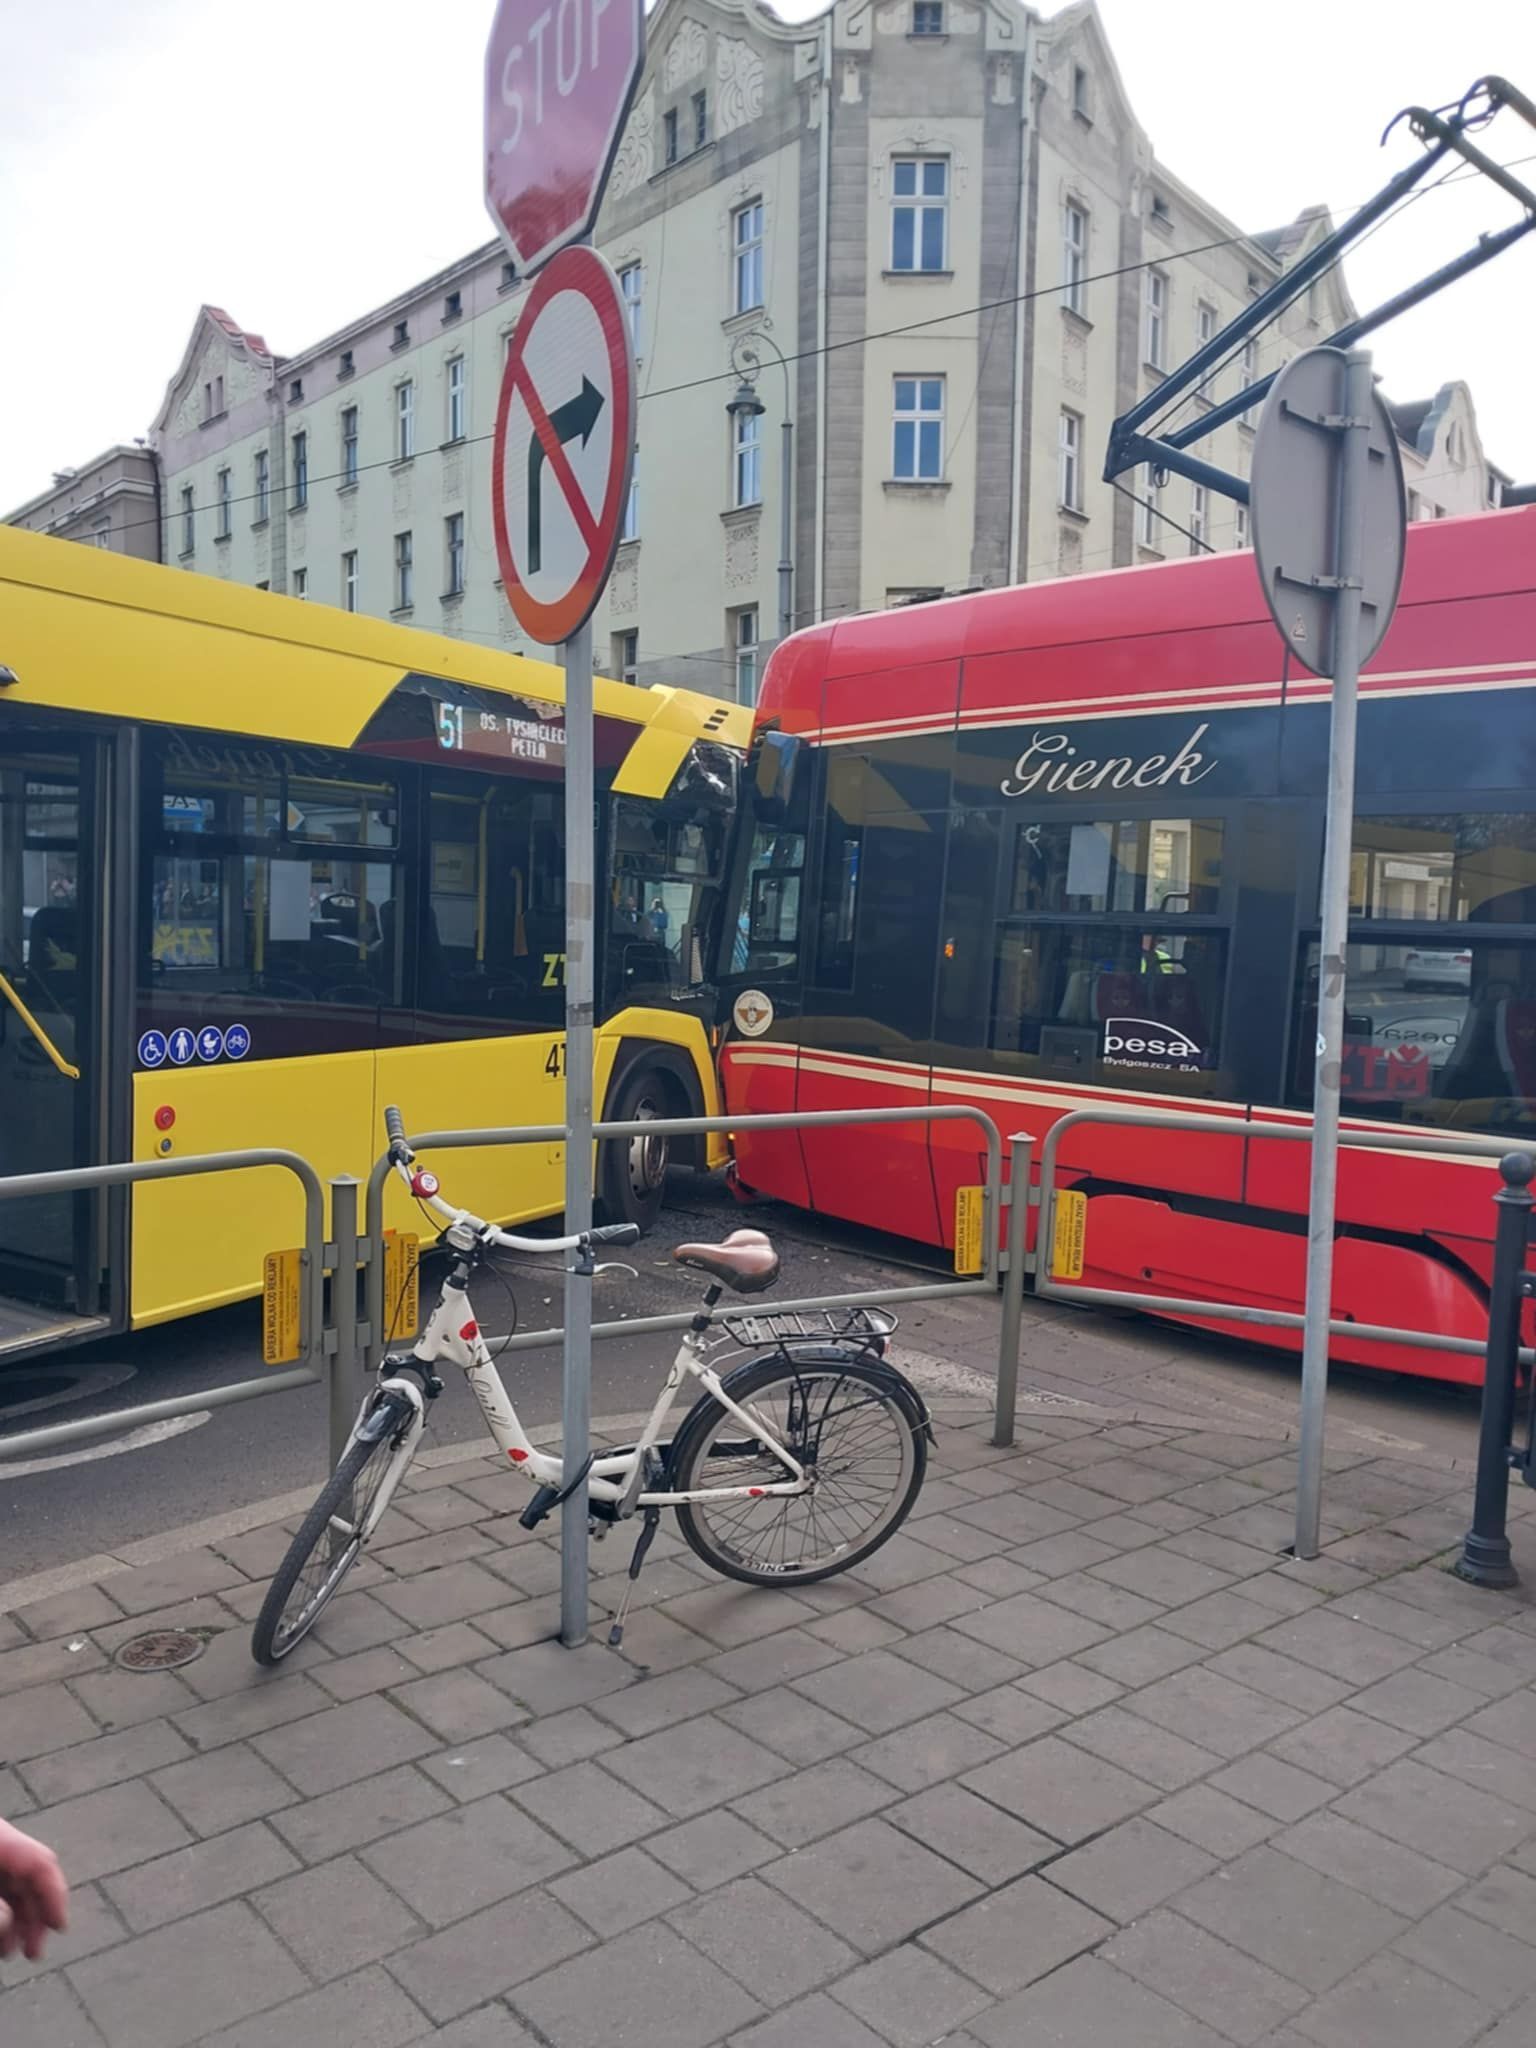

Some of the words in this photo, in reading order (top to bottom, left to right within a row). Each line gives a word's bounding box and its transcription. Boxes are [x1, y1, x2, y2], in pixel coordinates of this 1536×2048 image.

[439, 702, 464, 750] 51
[1001, 723, 1219, 797] Gienek
[1103, 1056, 1172, 1071] Bydgoszcz
[1104, 1036, 1189, 1057] pesa
